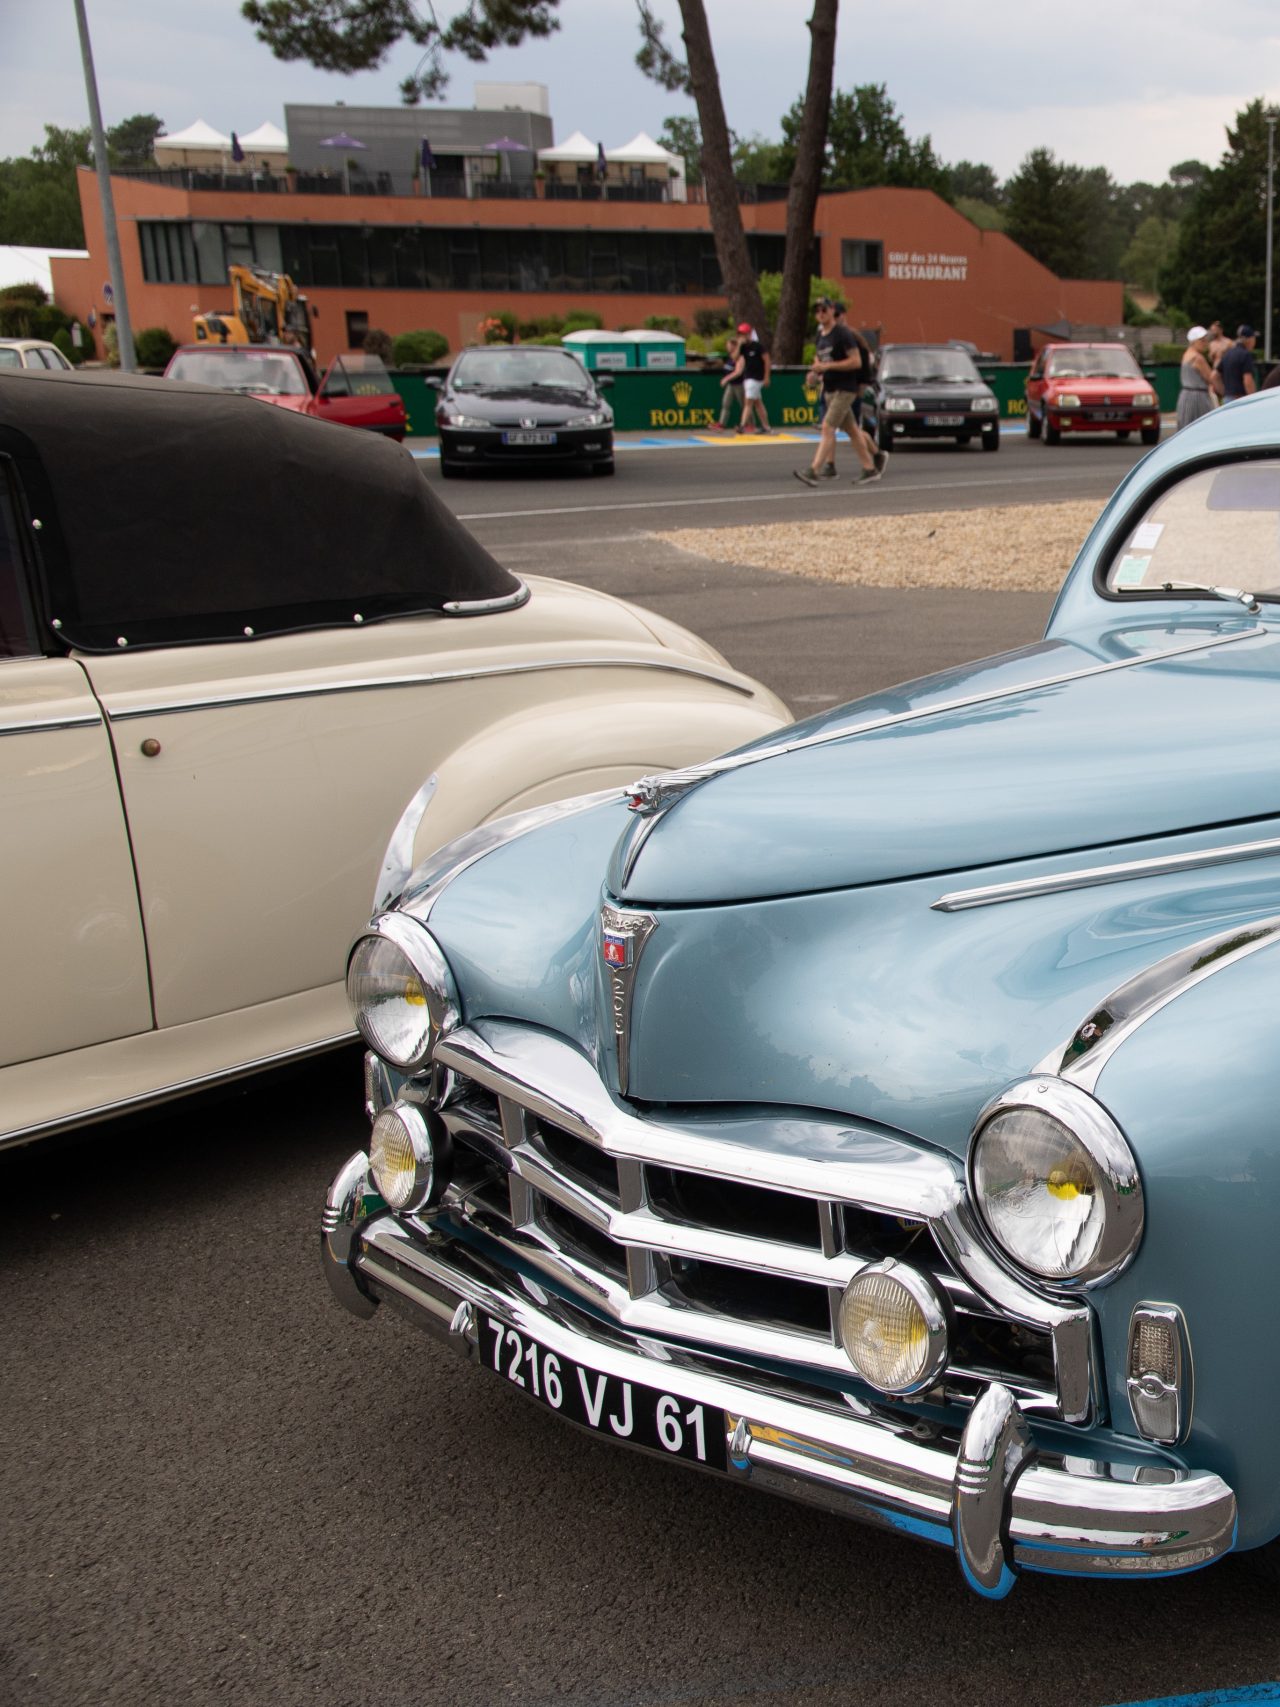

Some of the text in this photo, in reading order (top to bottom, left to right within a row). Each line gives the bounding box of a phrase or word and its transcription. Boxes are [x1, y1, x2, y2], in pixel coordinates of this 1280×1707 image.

[911, 252, 925, 264] des
[888, 264, 968, 281] RESTAURANT
[650, 408, 715, 426] ROLEX
[783, 406, 819, 423] ROL
[488, 1317, 707, 1461] 7216 VJ 61
